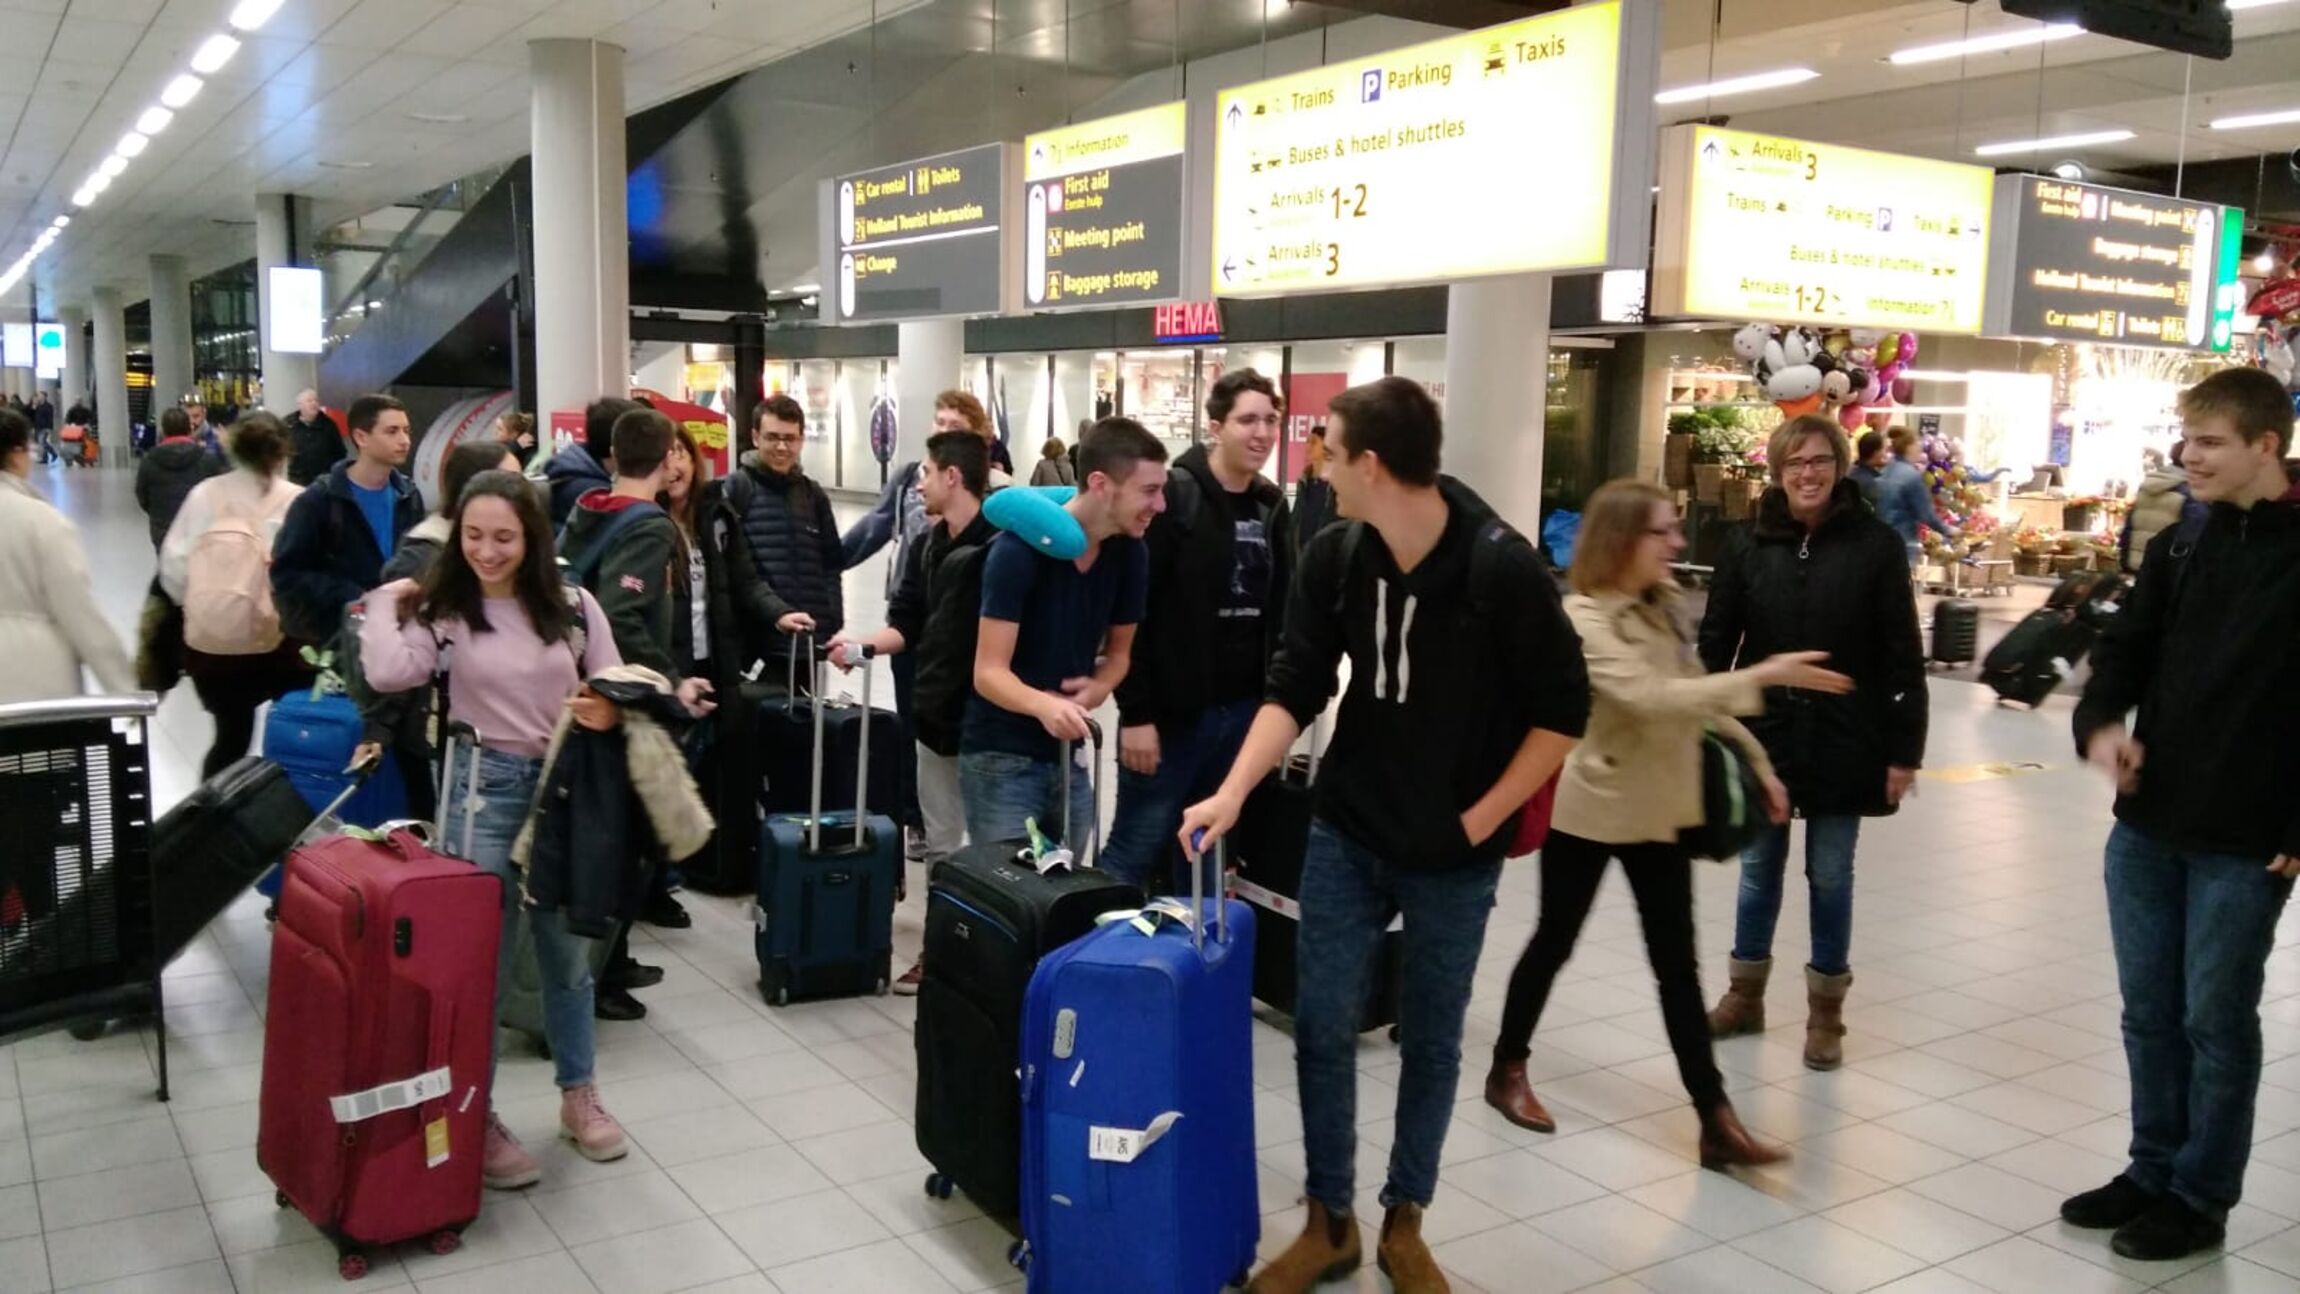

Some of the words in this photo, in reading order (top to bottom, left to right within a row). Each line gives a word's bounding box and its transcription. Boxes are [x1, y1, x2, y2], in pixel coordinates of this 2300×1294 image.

[1515, 34, 1566, 64] Taxis
[1387, 62, 1453, 91] Parking
[1291, 86, 1335, 111] Trains
[1288, 141, 1330, 165] Buses
[1334, 138, 1345, 157] &
[1351, 128, 1392, 154] hotel
[1396, 117, 1466, 147] shuttles
[1752, 141, 1803, 163] Arrivals
[1805, 153, 1817, 181] 3
[1064, 175, 1088, 195] First
[1090, 169, 1109, 191] aid
[1270, 184, 1325, 208] Arrivals
[1331, 183, 1368, 219] 1-2
[1727, 191, 1767, 214] Trains
[1064, 226, 1110, 248] Meeting
[1112, 221, 1144, 246] point
[866, 256, 897, 274] Change
[1268, 239, 1322, 261] Arrivals
[1325, 242, 1339, 276] 3
[1063, 274, 1110, 295] Baggage
[1112, 269, 1159, 290] storage
[1795, 285, 1826, 313] 1-2
[1155, 302, 1218, 335] HEMA
